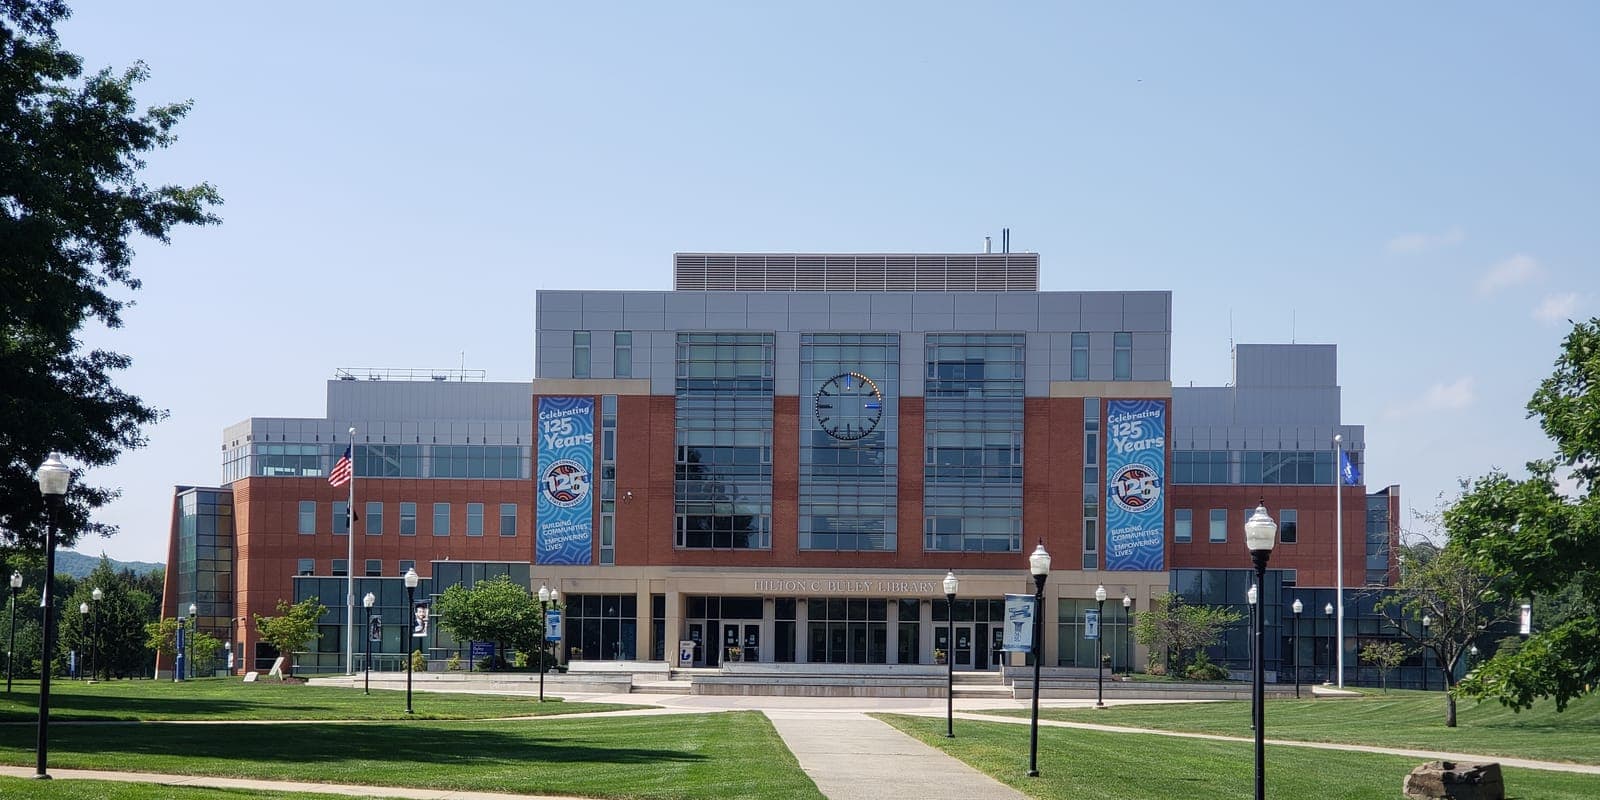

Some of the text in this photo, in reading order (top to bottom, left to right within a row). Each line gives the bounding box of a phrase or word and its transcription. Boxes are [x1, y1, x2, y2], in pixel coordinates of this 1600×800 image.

[539, 406, 589, 420] Celebrating
[1108, 410, 1160, 423] Celebrating
[544, 417, 572, 434] 125
[1113, 421, 1142, 438] 125
[544, 433, 592, 449] Years
[1113, 437, 1164, 454] Years
[549, 472, 585, 494] 125
[1118, 477, 1155, 499] 125
[542, 520, 572, 530] BUILDING
[543, 524, 588, 536] COMMUNITIES
[1112, 525, 1142, 536] BUILDING
[545, 533, 588, 544] EMPOWERING
[1112, 529, 1159, 541] COMMUNITIES
[546, 544, 562, 552] LIVES
[1114, 538, 1160, 550] EMPOWERING
[754, 580, 936, 592] HILTON C. BULEY LIBRARY
